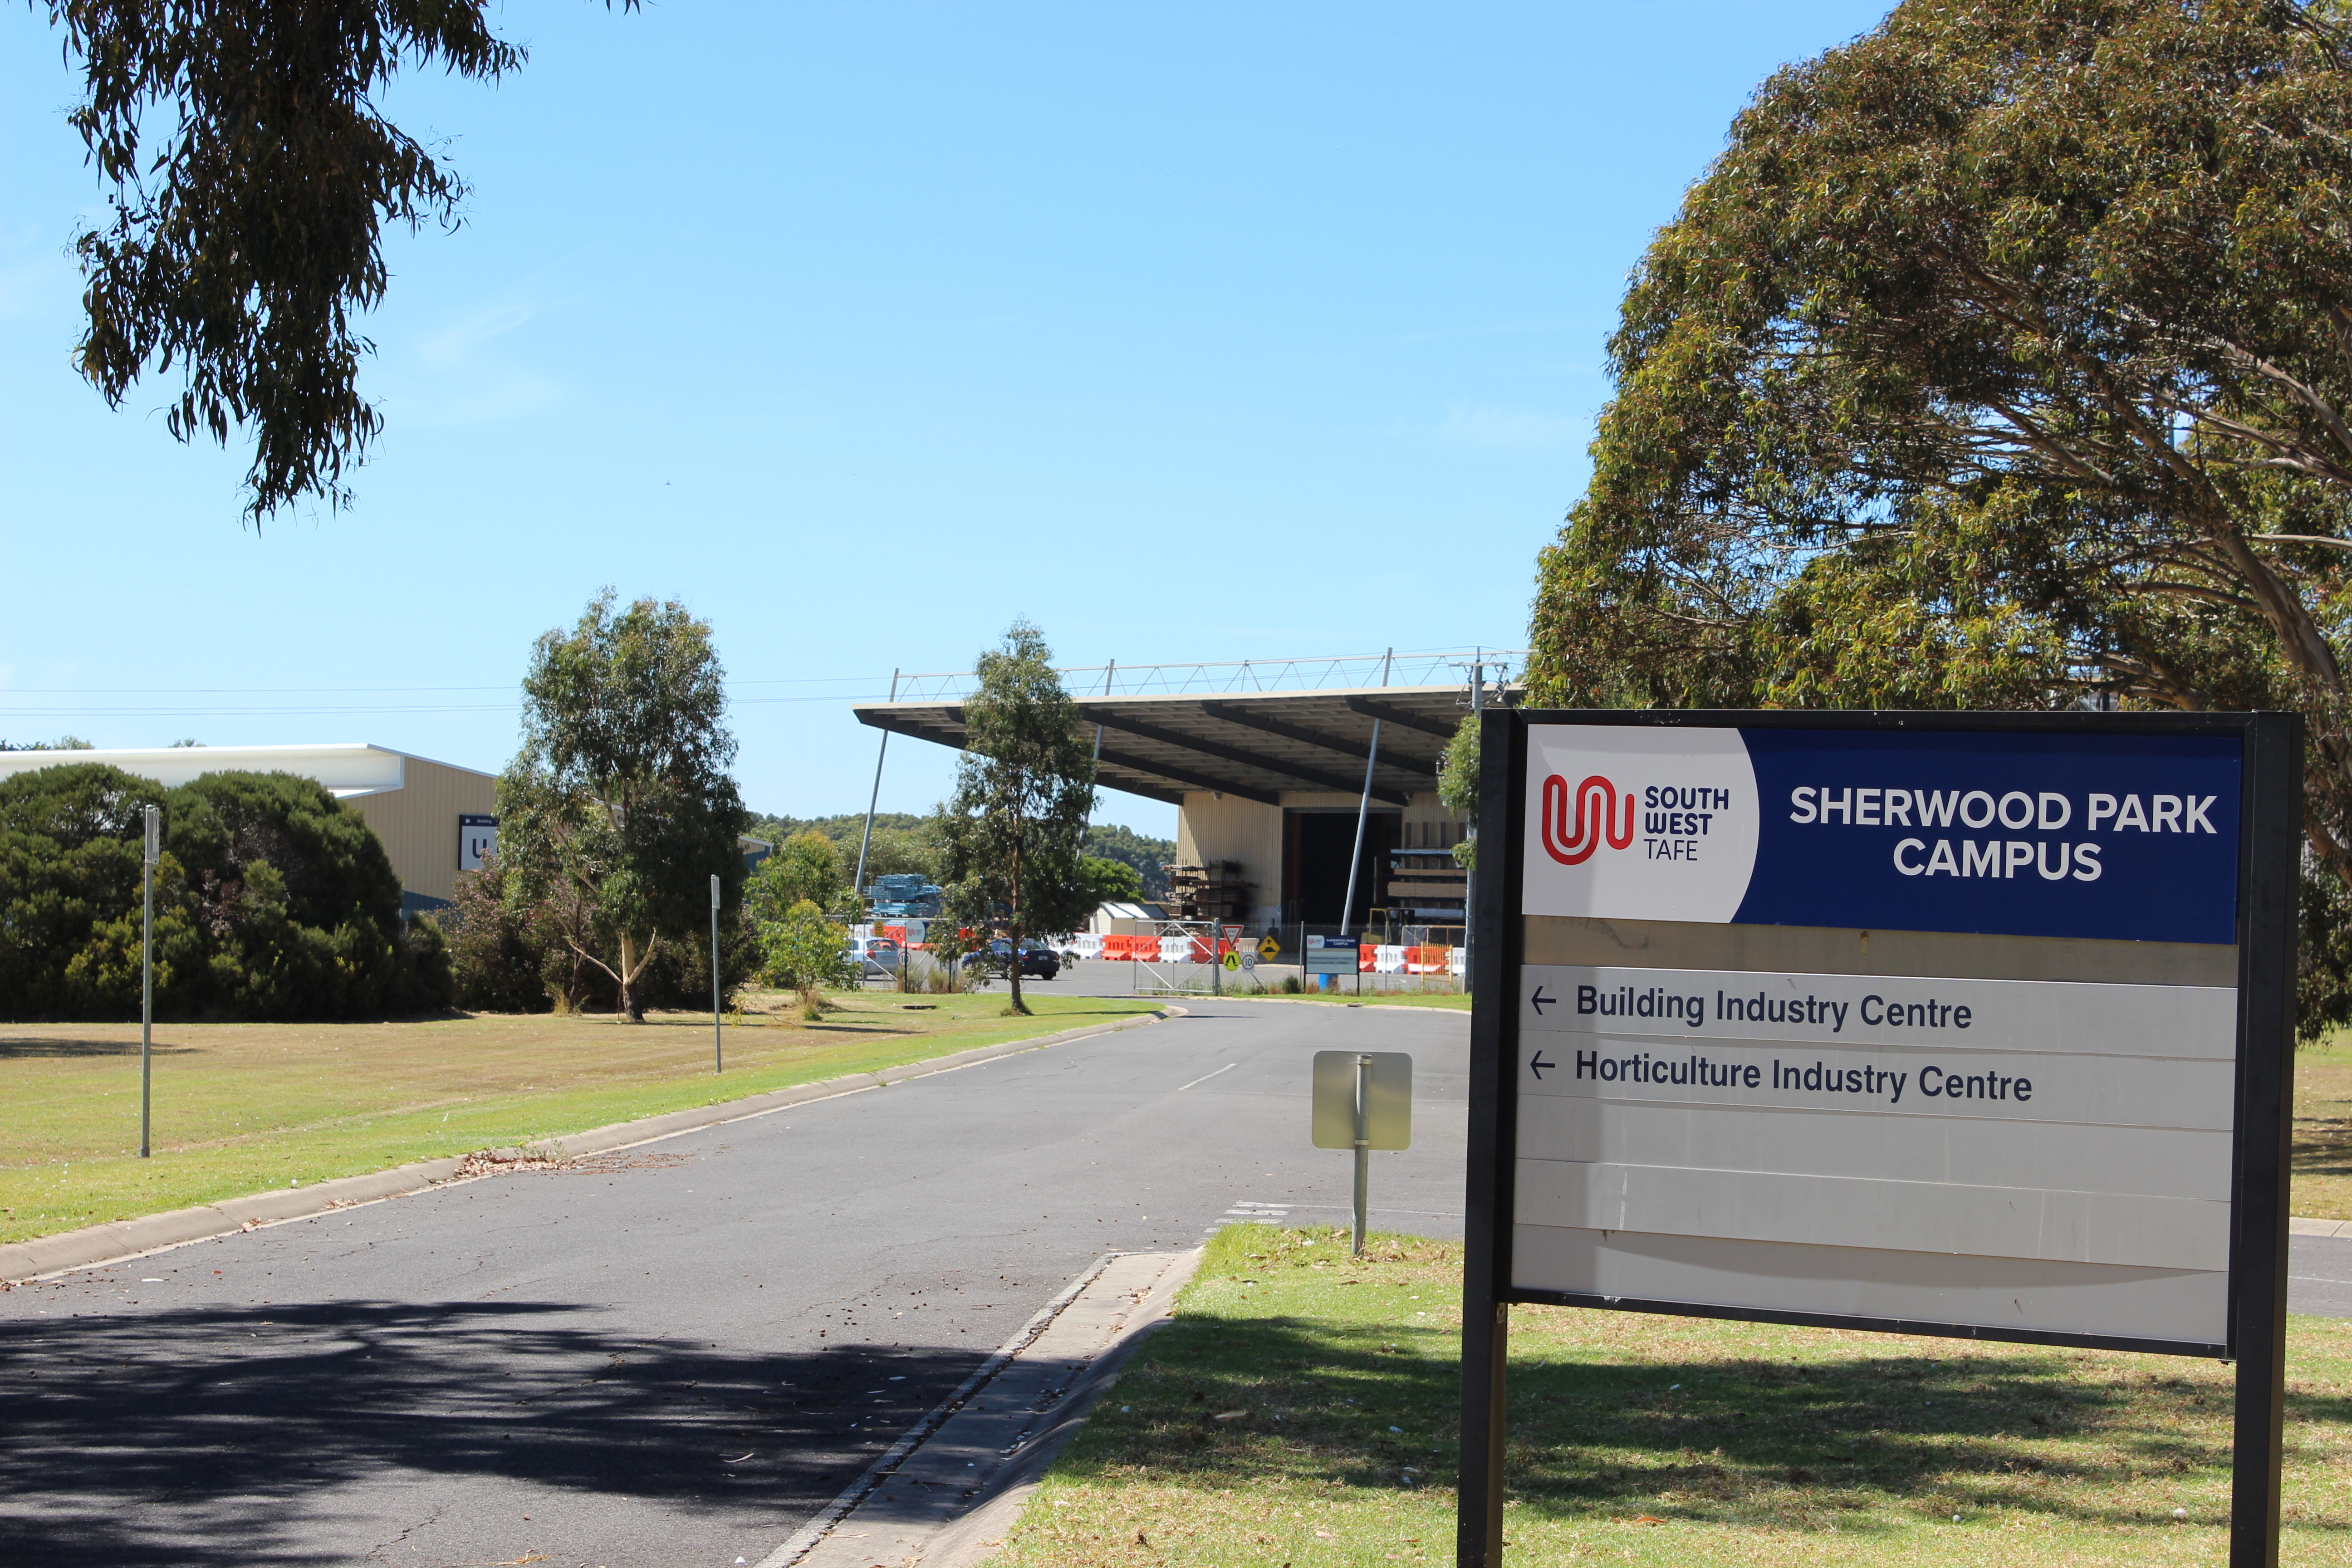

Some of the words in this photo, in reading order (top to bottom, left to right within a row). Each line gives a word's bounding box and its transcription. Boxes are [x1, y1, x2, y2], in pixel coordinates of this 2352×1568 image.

[1645, 786, 1729, 810] SOUTH
[1790, 786, 2071, 829] SHERWOOD
[2088, 793, 2217, 833] PARK
[1645, 812, 1713, 836] WEST
[1643, 838, 1698, 861] TAFE
[1893, 838, 2102, 881] CAMPUS
[1245, 958, 1252, 966] 10
[1577, 985, 1704, 1028] Building
[1717, 990, 1849, 1033] Industry
[1861, 995, 1972, 1029] Centre
[1576, 1049, 1761, 1088] Horticulture
[1773, 1059, 1907, 1103] Industry
[1919, 1066, 2032, 1102] Centre
